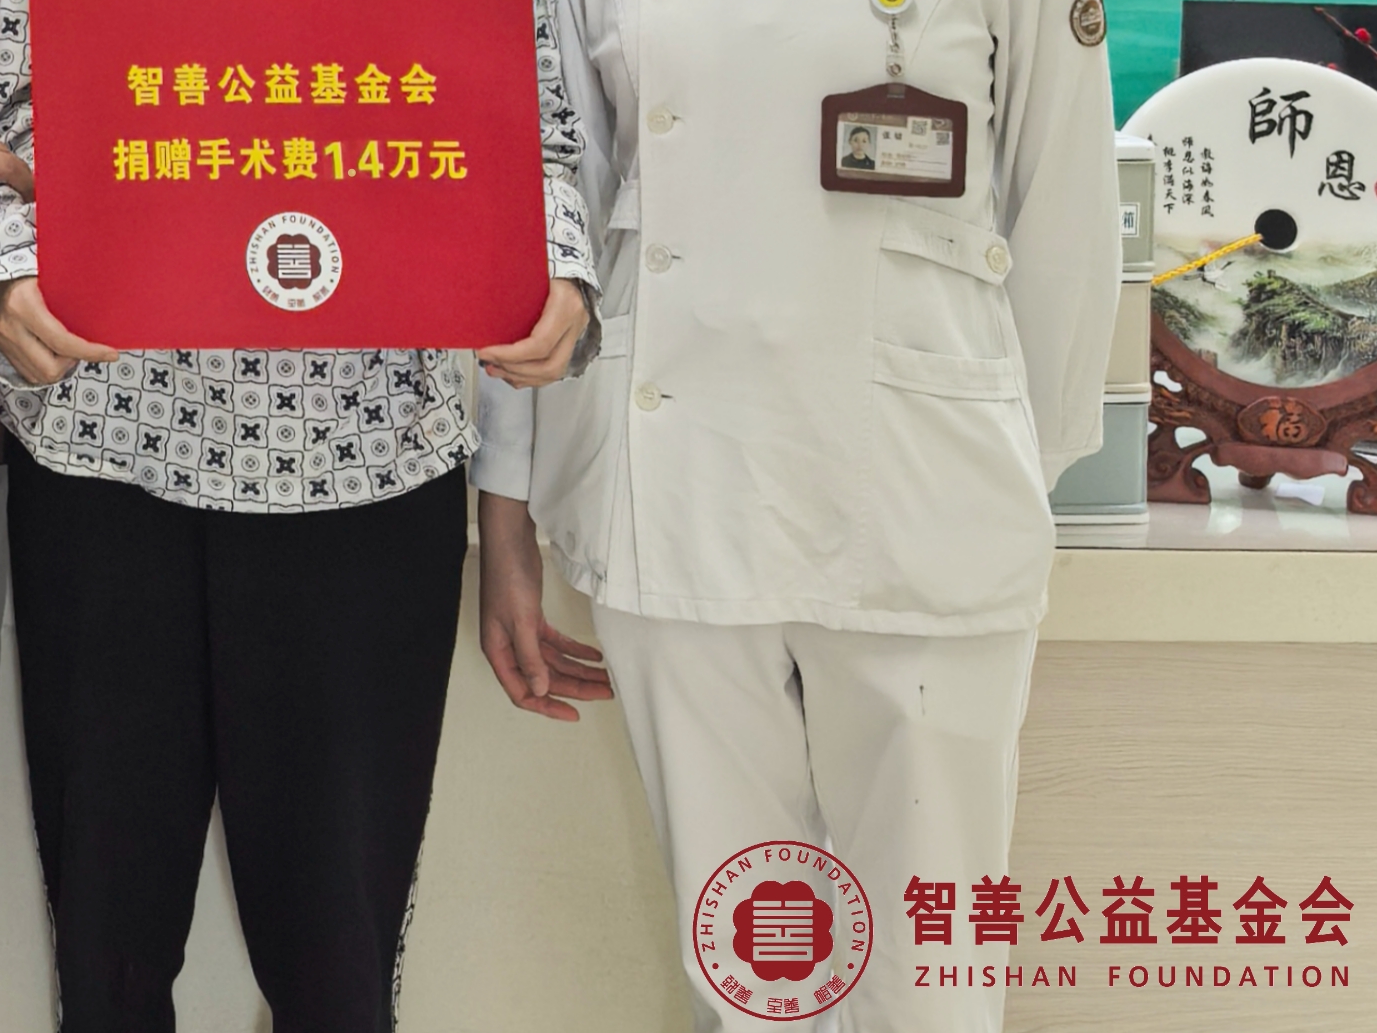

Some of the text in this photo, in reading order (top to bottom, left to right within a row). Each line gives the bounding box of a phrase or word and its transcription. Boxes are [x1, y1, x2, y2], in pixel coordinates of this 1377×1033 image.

[127, 63, 438, 106] 智善公益基金会
[112, 137, 468, 180] 捐赠手术费1.4万元
[249, 215, 339, 273] ZHISHAN FOUNDATION
